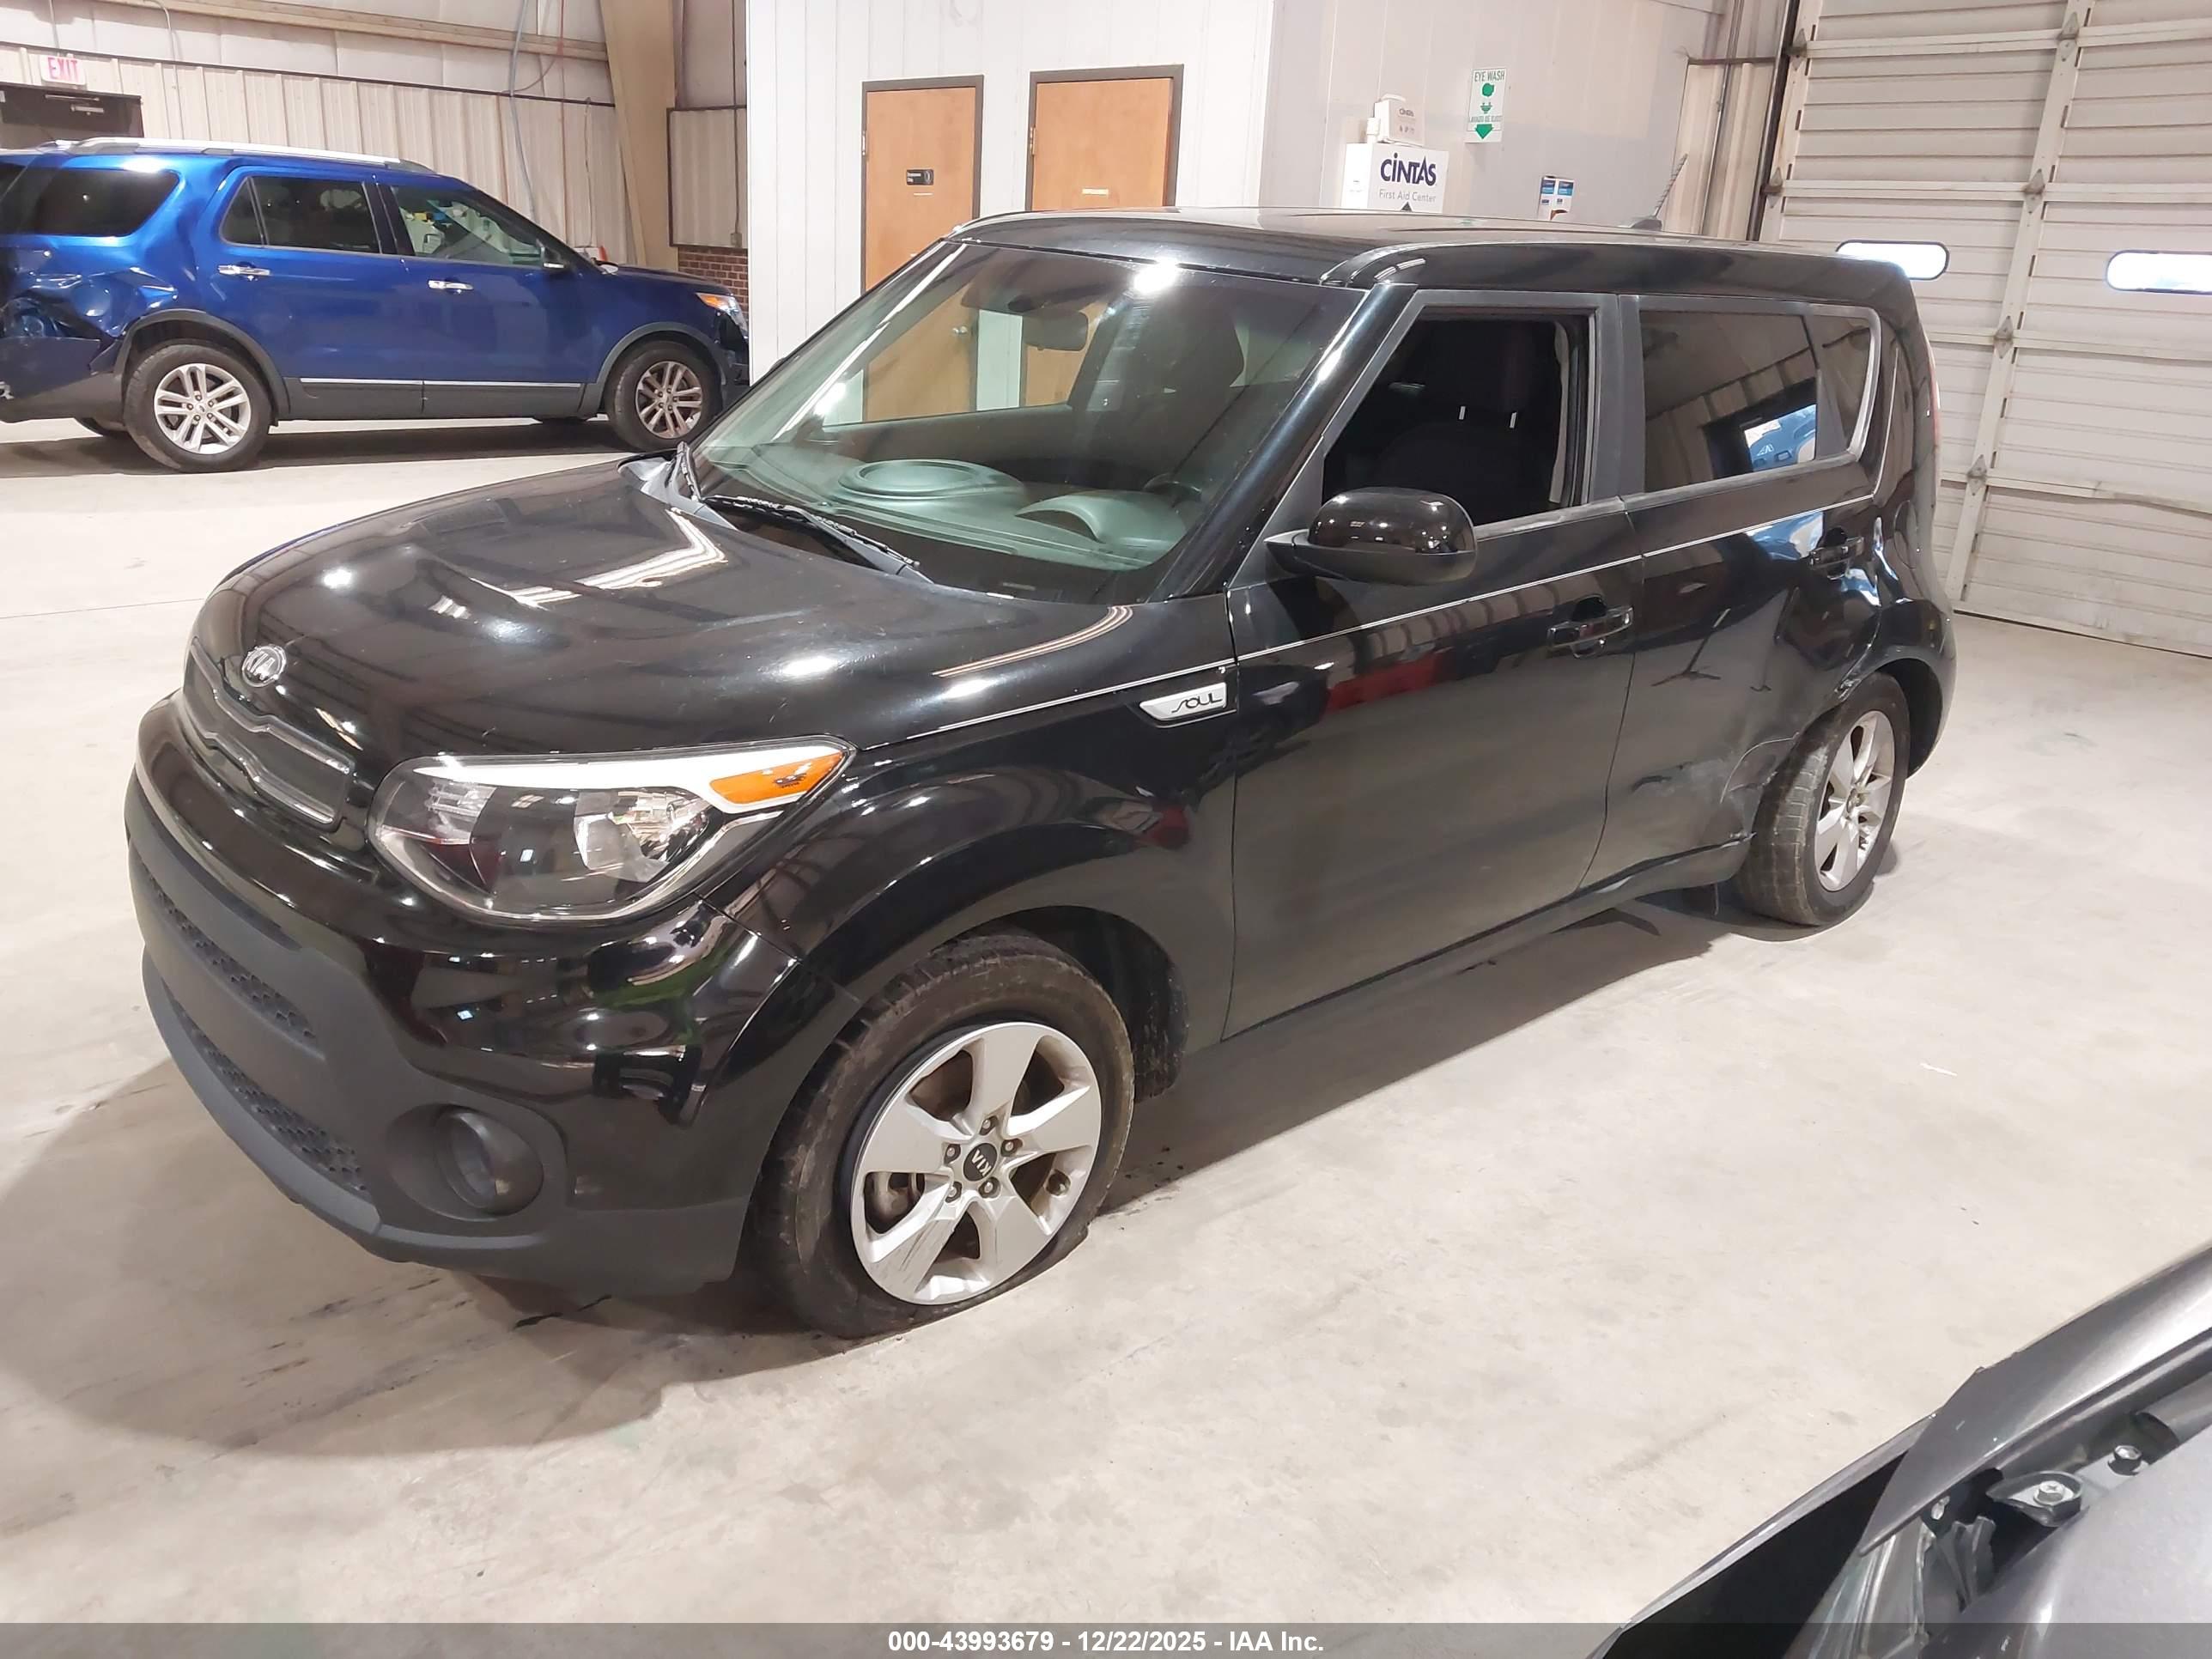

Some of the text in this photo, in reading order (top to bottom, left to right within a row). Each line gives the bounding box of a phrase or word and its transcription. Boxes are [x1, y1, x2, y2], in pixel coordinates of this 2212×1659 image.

[47, 57, 78, 82] EXIT
[1474, 70, 1505, 82] EYE WASH
[1379, 189, 1437, 203] First Aid Center
[971, 1149, 992, 1176] KIA
